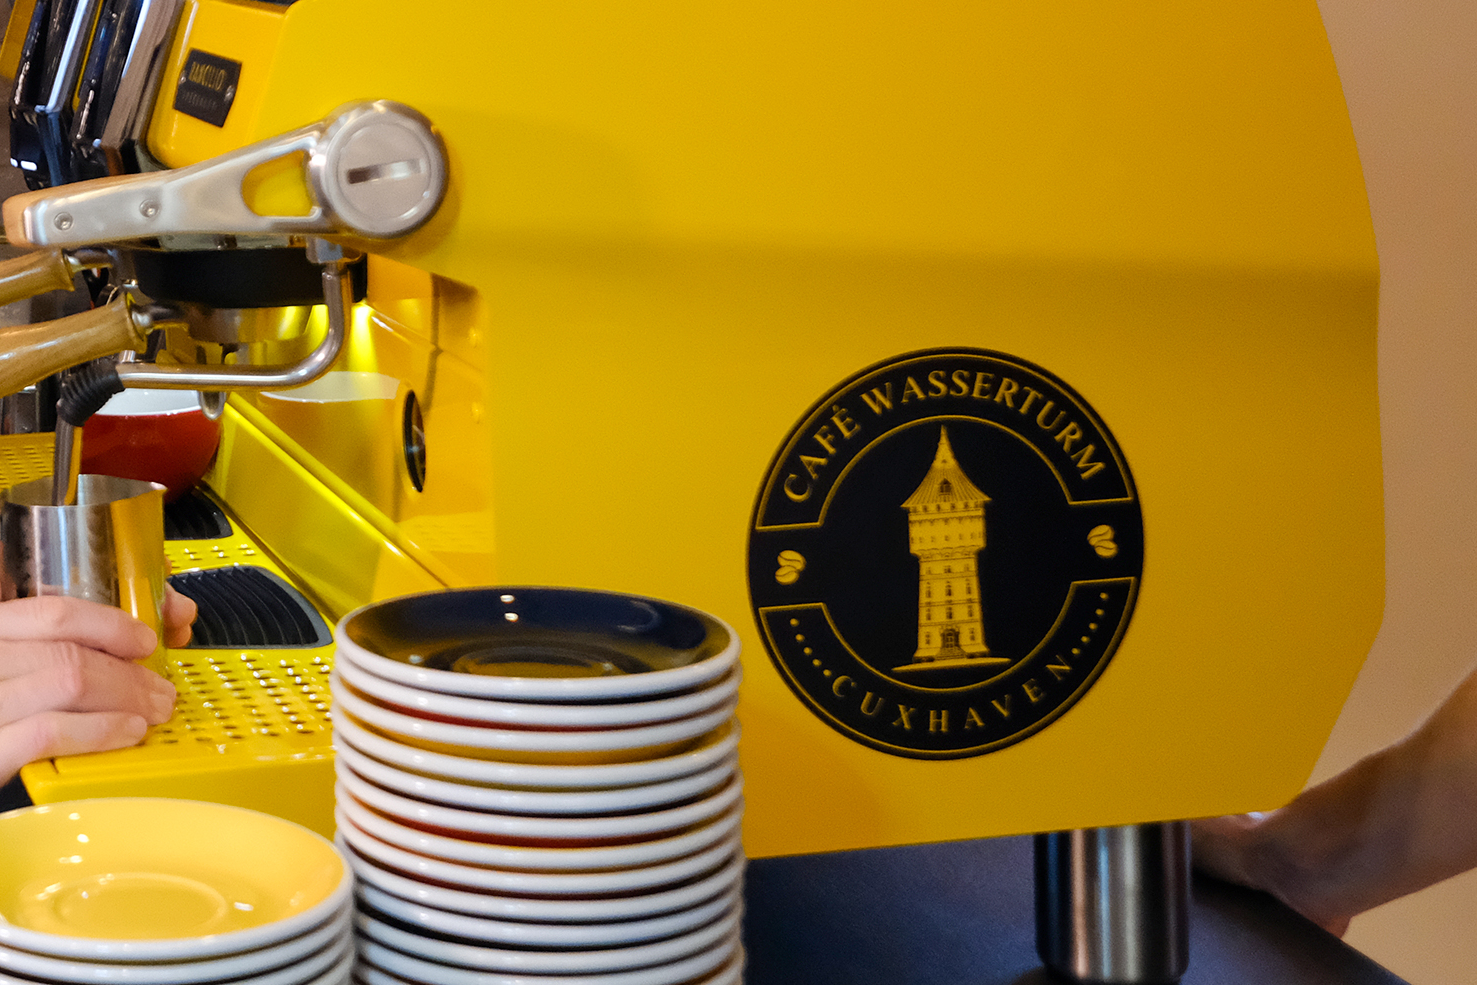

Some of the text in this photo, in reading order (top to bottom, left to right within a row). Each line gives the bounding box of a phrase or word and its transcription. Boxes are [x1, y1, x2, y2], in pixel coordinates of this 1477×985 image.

[783, 369, 1107, 502] CAFÉ WASSERTURM
[830, 654, 1073, 733] CUXHAVEN
